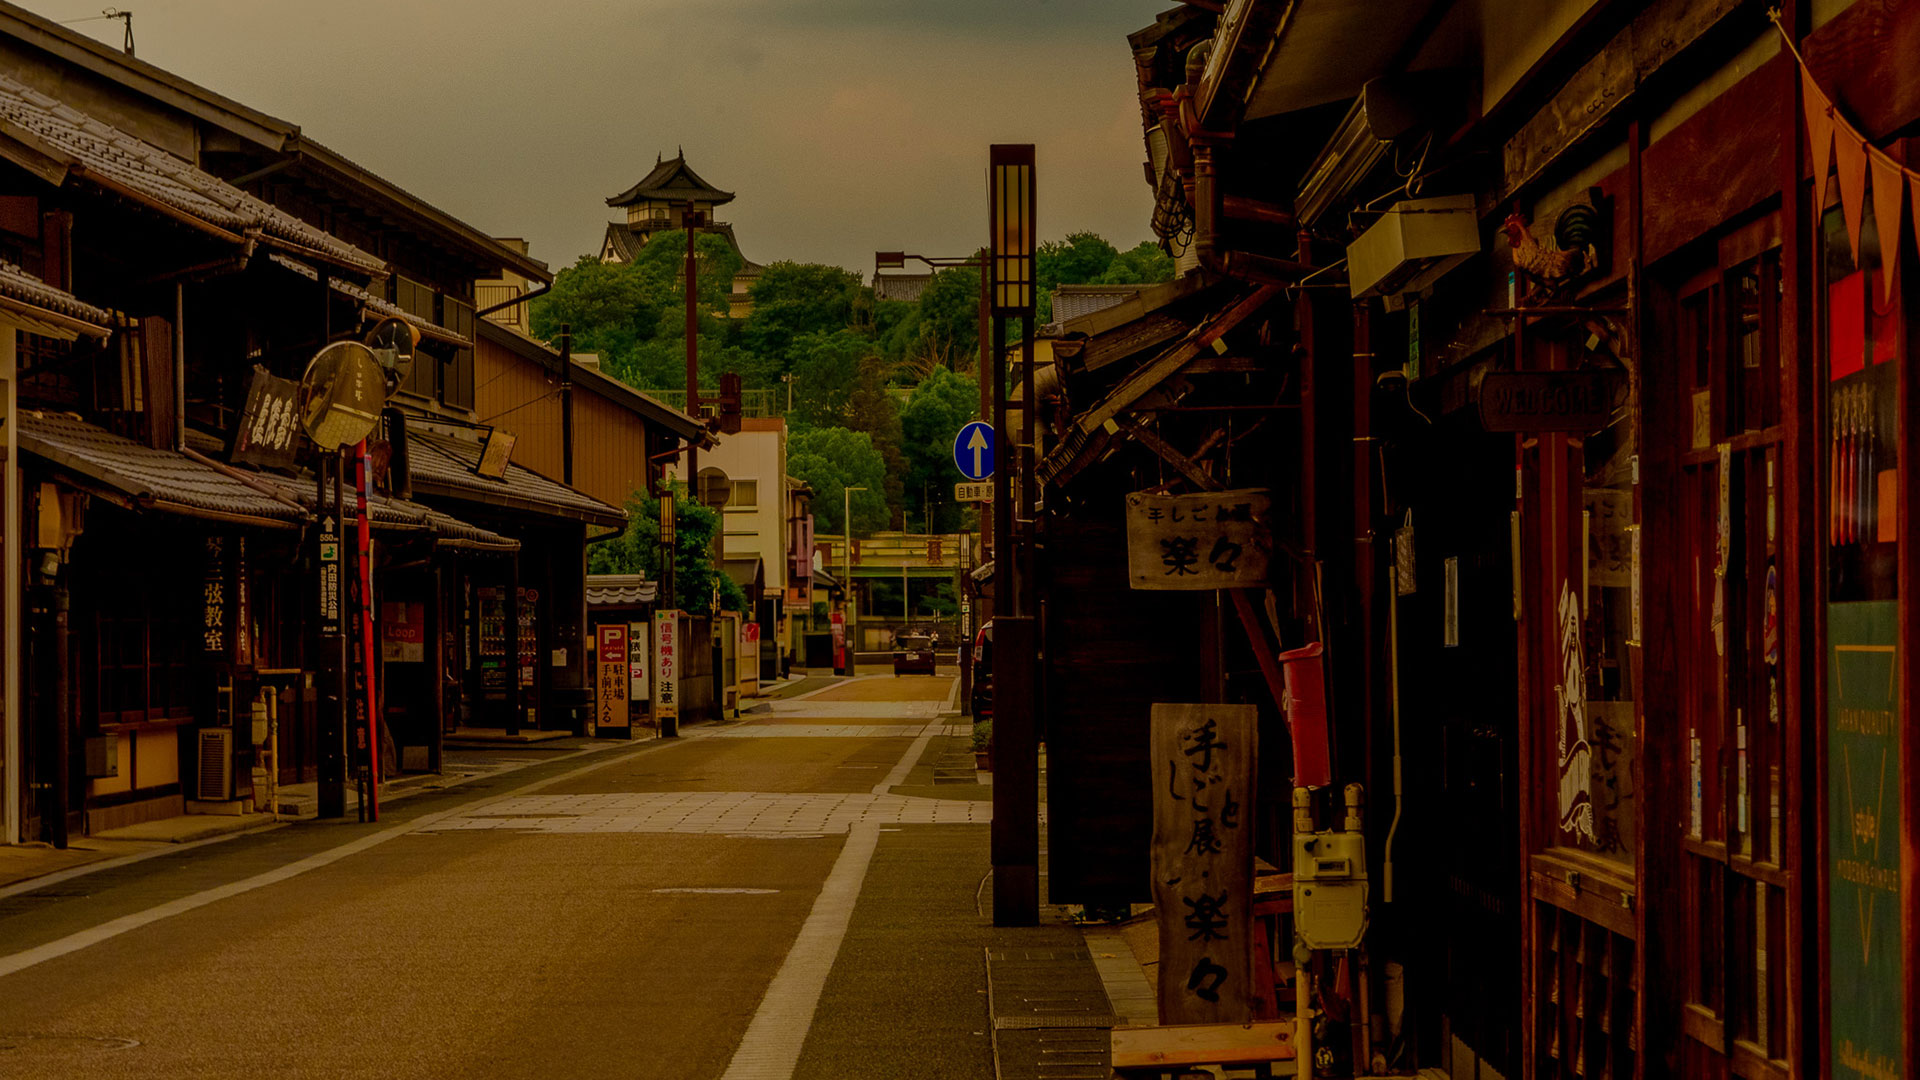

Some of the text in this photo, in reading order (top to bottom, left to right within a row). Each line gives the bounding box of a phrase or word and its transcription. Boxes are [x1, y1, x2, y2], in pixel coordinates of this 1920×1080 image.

[1497, 386, 1603, 415] WELCOME
[1160, 536, 1242, 576] 楽々
[327, 563, 338, 620] 内田防災公園
[604, 629, 622, 644] P
[660, 623, 674, 678] 信号機あり
[613, 664, 625, 701] 駐車場
[632, 669, 641, 678] P
[601, 664, 613, 723] 手前左入る
[660, 681, 674, 704] 注意
